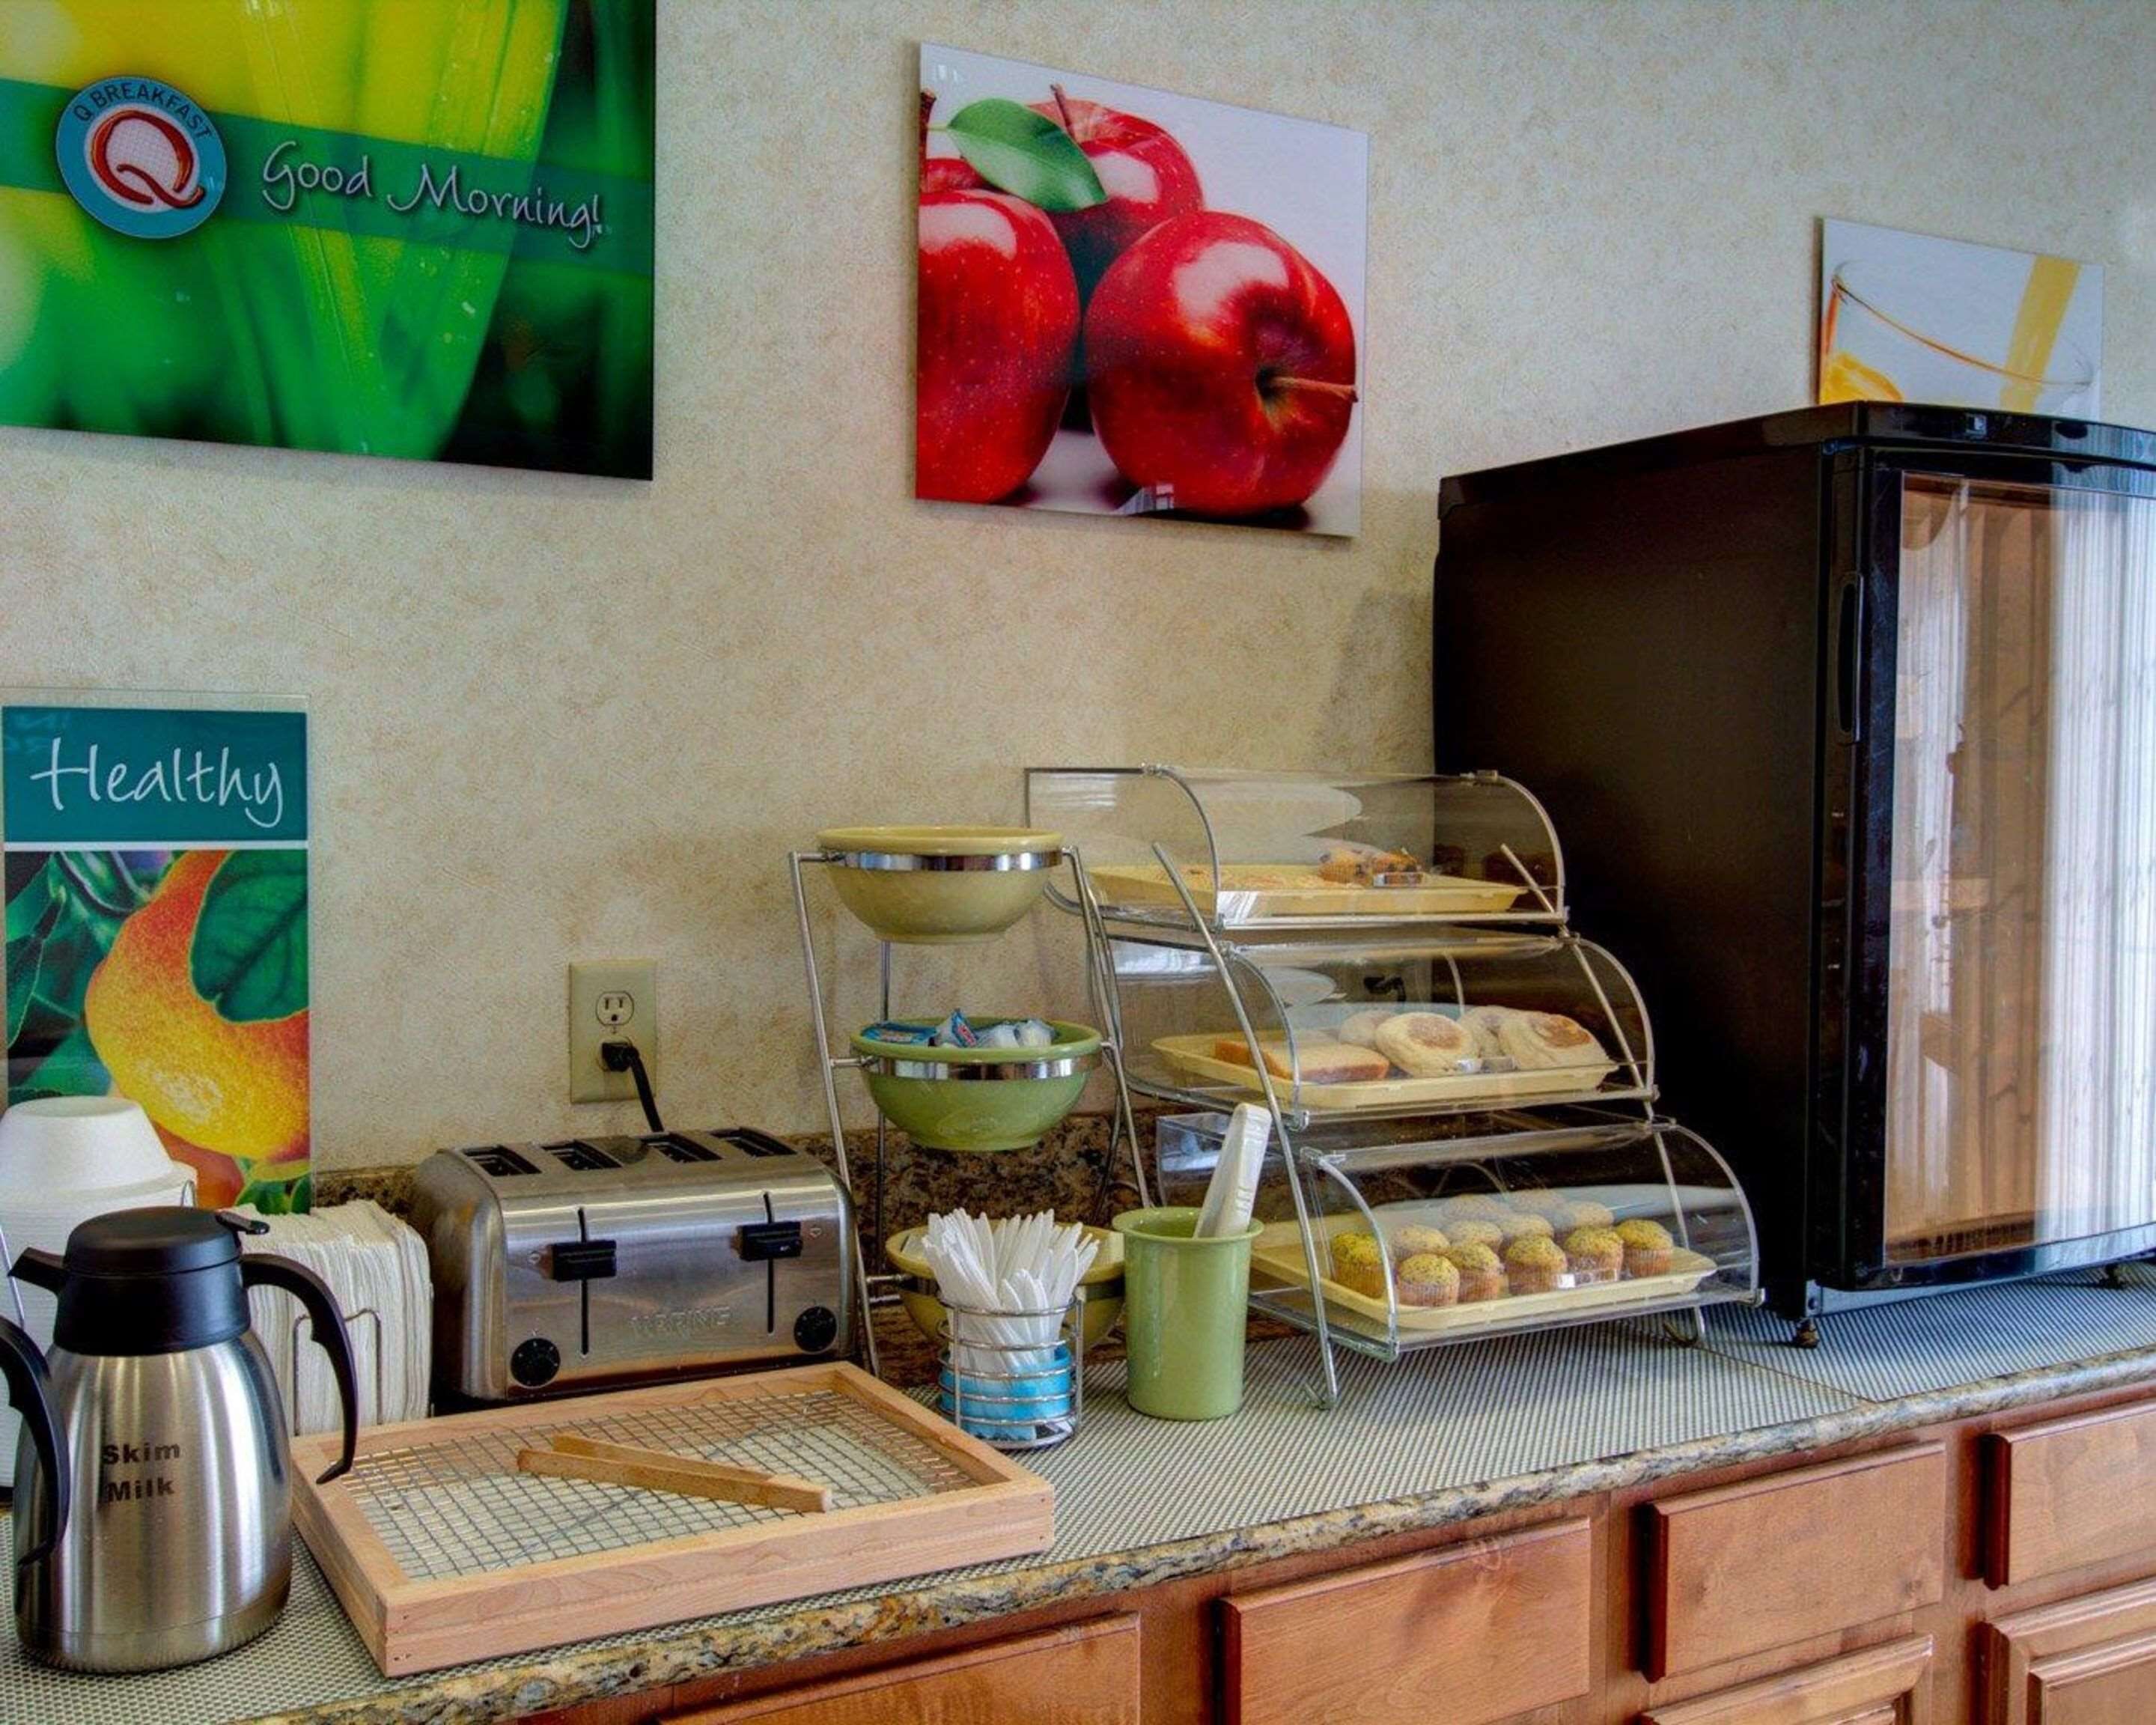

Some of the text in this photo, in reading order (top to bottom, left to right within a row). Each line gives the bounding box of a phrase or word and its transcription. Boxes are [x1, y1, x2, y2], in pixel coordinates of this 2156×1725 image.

[73, 82, 213, 139] Q BREAKFAST
[261, 139, 603, 249] Good Morning!
[29, 737, 284, 828] Healthy
[102, 1442, 180, 1464] Skim
[106, 1477, 175, 1502] Milk
